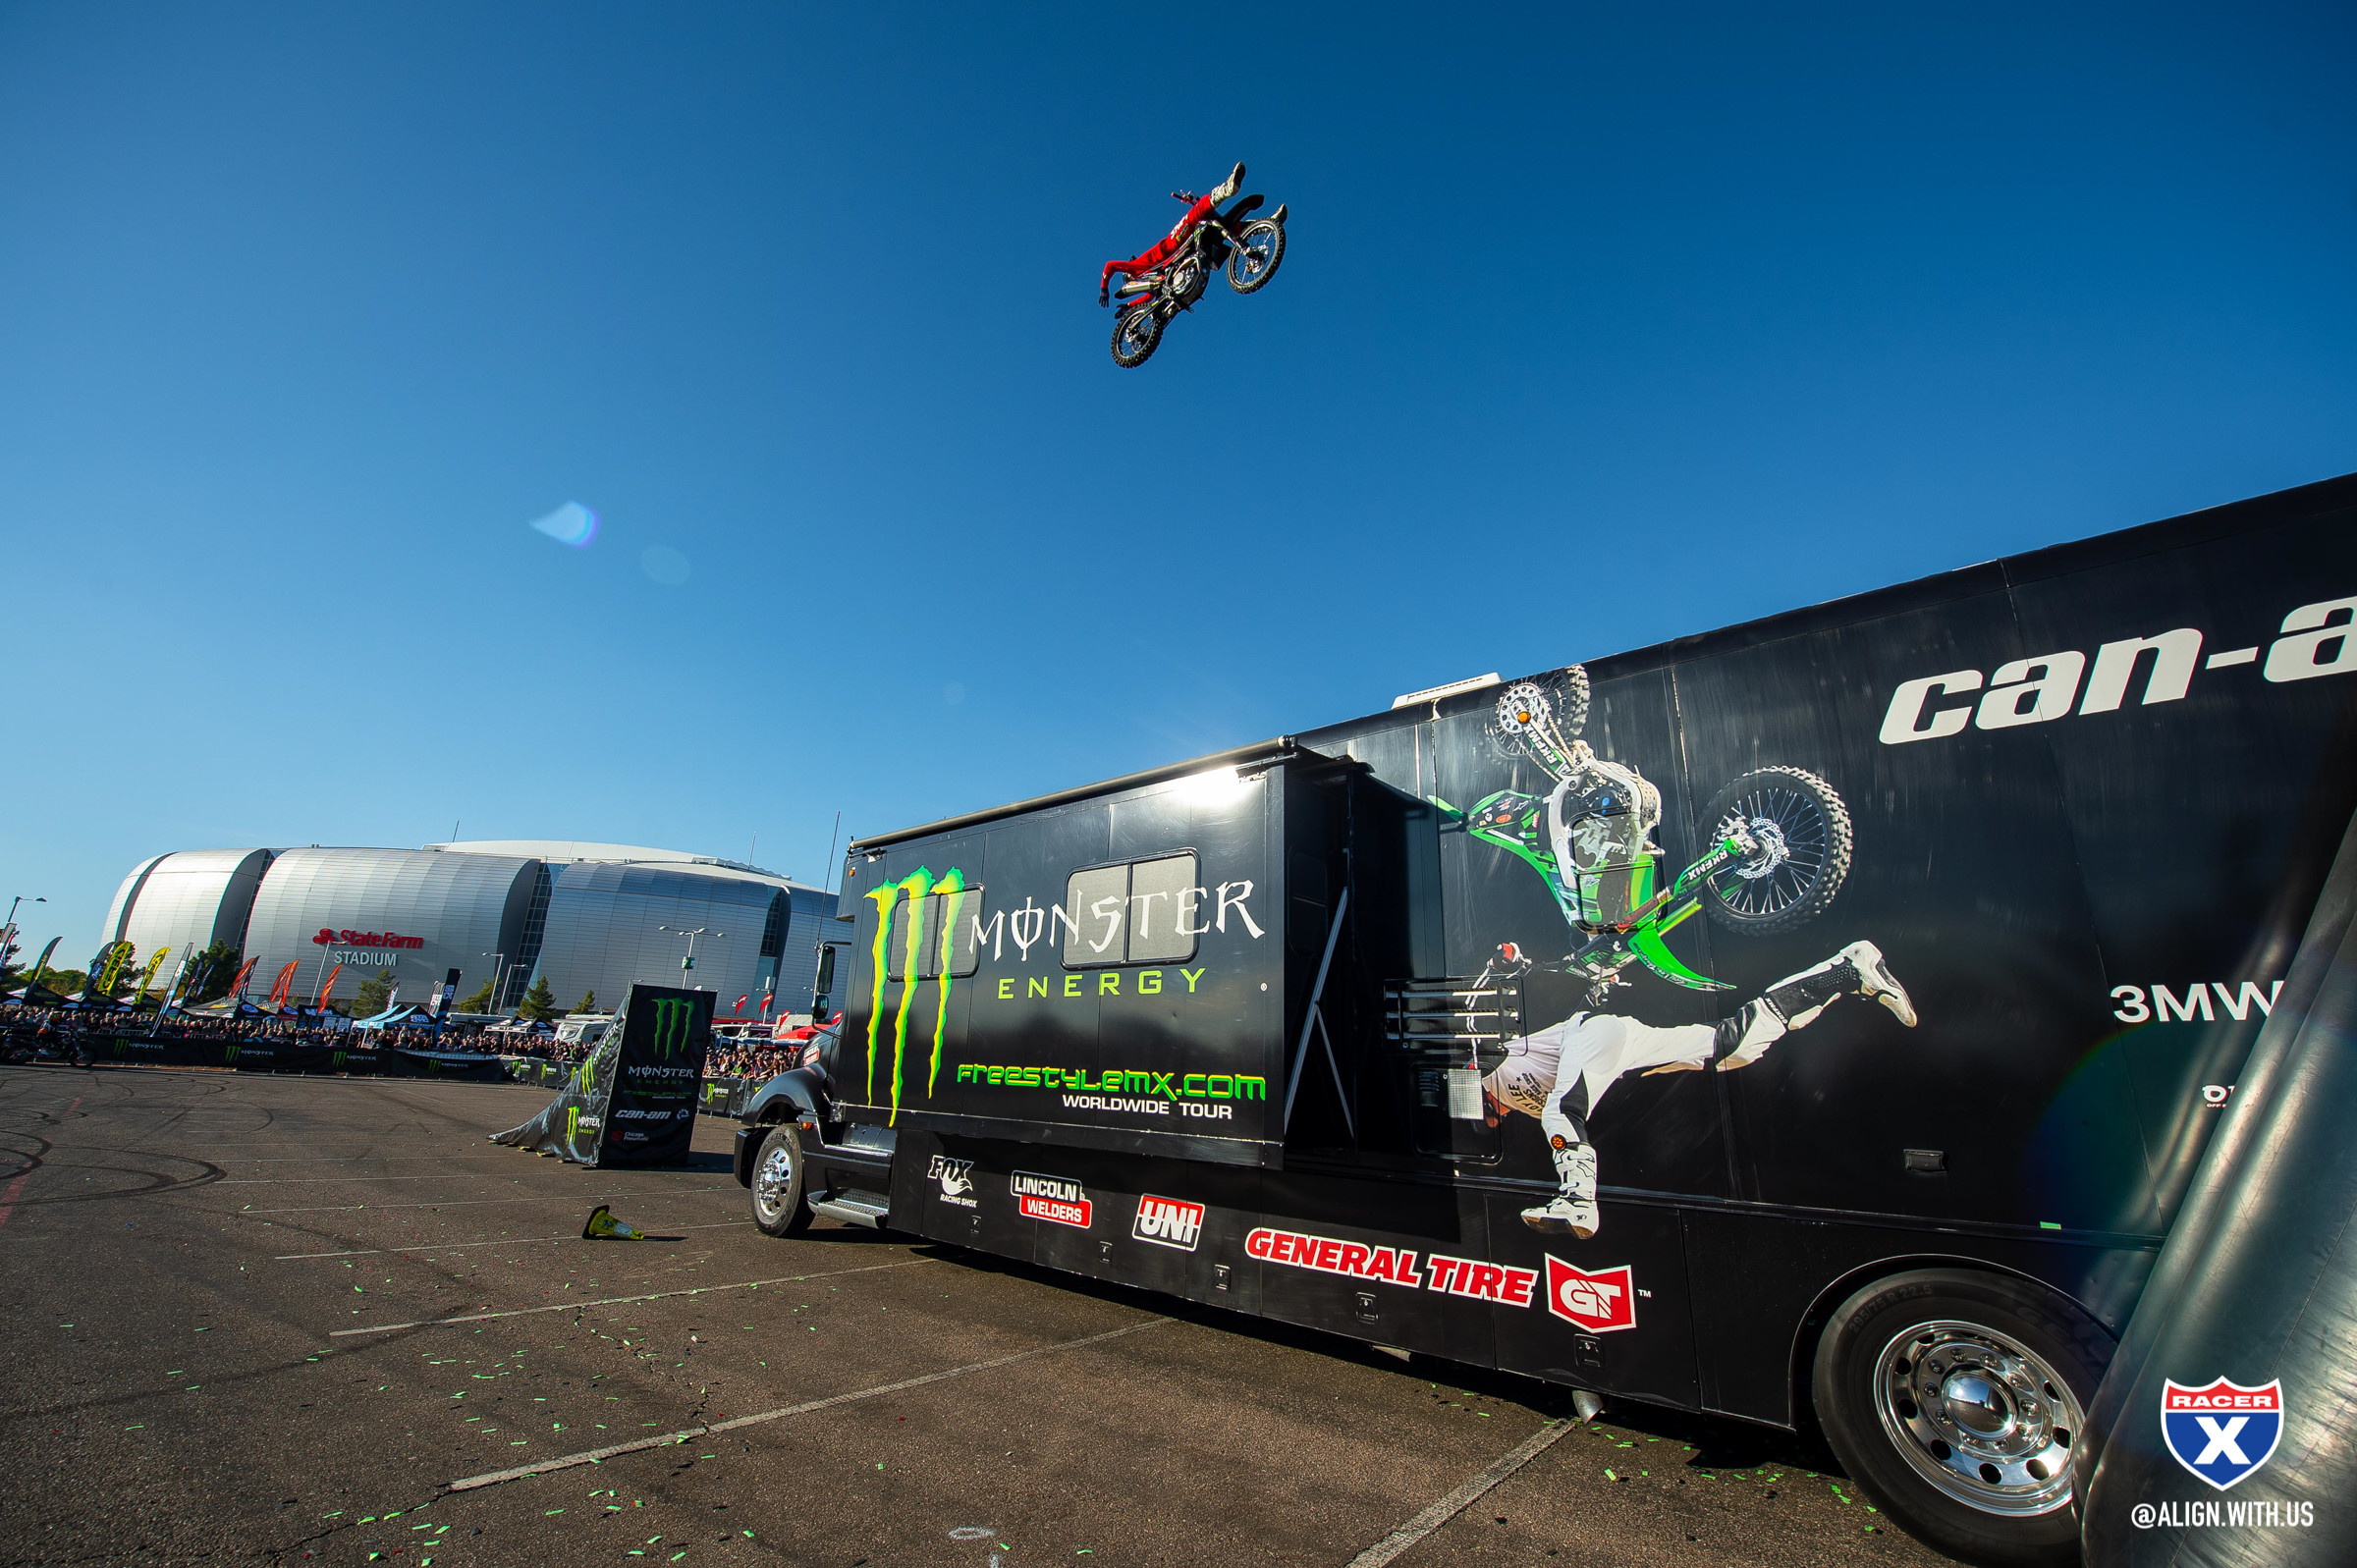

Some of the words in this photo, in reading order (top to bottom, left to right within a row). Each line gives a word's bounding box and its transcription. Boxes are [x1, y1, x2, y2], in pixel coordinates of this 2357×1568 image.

[969, 879, 1265, 961] MONSTER
[334, 950, 398, 966] STADIUM
[998, 968, 1206, 1000] ENERGY
[629, 1065, 694, 1078] MONSTER
[615, 1109, 671, 1119] can-am
[1063, 1095, 1170, 1115] WORLDWIDE
[1178, 1102, 1233, 1120] TOUR
[927, 1155, 974, 1183] FOX
[940, 1194, 961, 1205] RACING
[961, 1198, 977, 1208] SHOX
[1014, 1175, 1077, 1202] LINCOLN
[1026, 1198, 1082, 1222] WELDERS
[1140, 1201, 1200, 1245] UNI
[1246, 1229, 1420, 1286] GENERAL
[1427, 1255, 1538, 1307] TIRE
[1560, 1279, 1621, 1319] GT
[1899, 1285, 1933, 1298] 22.5
